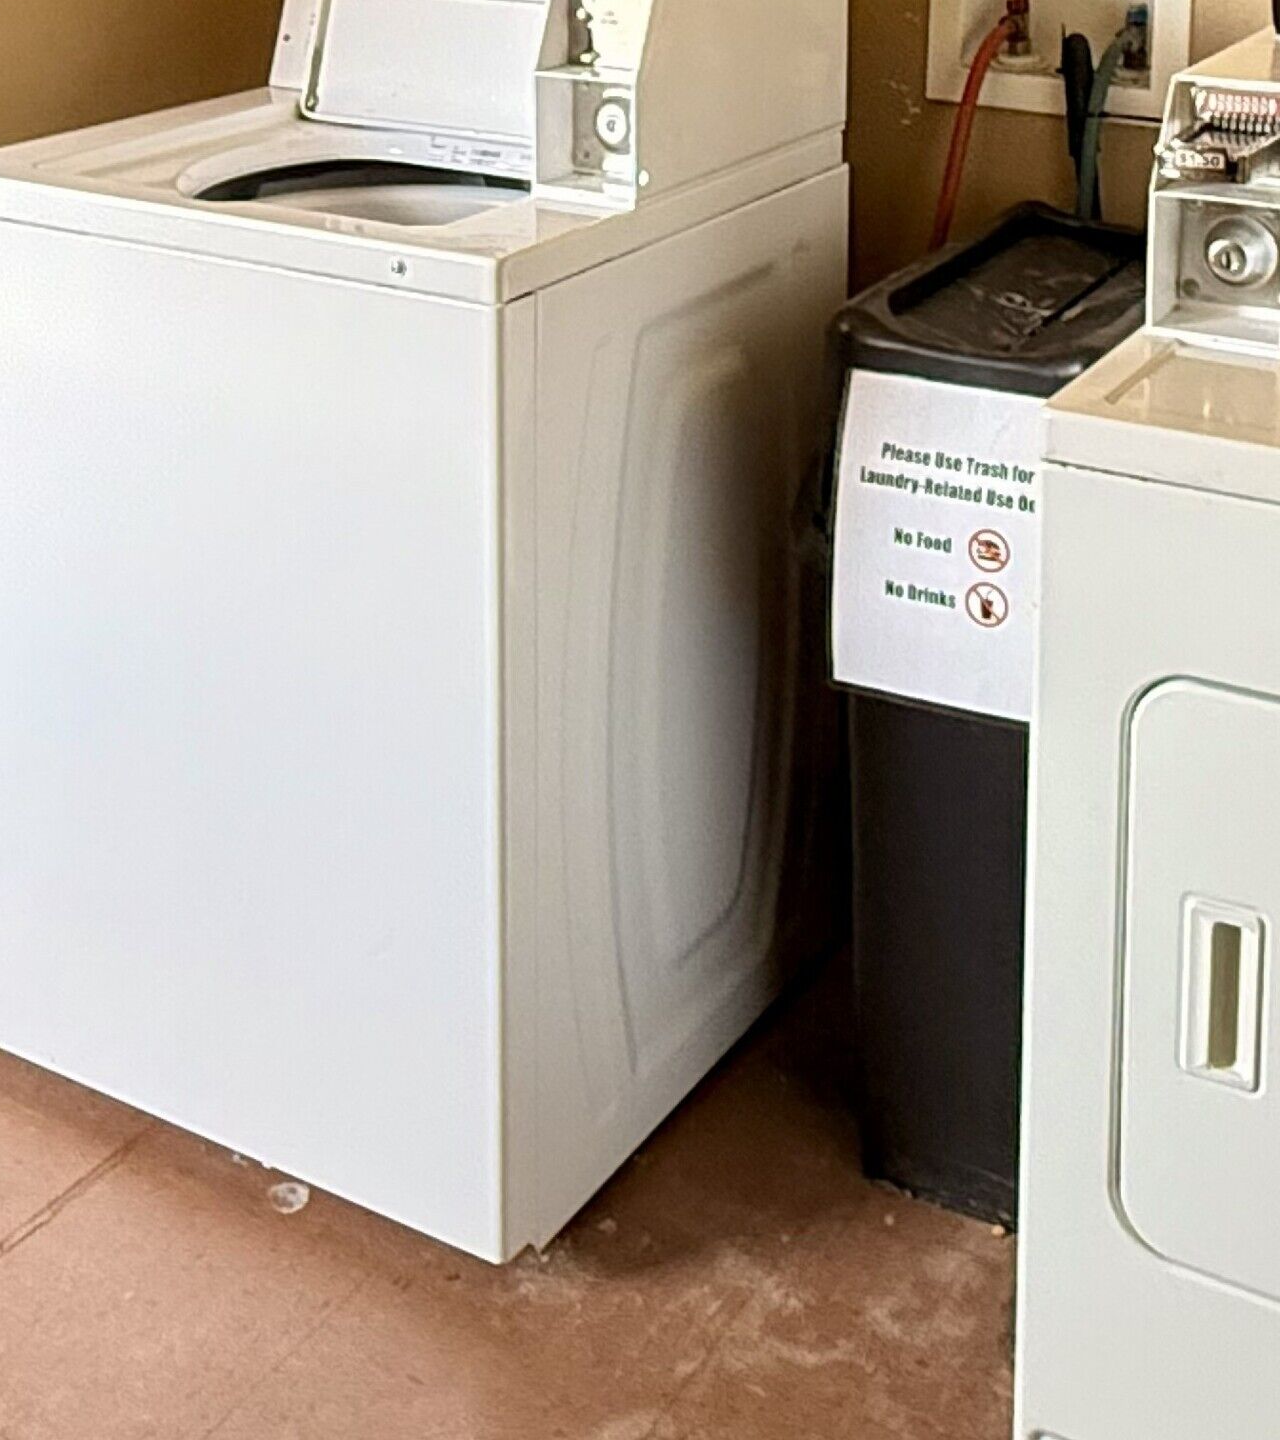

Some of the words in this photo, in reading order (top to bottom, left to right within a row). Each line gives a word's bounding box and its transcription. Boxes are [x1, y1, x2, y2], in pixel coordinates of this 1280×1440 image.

[881, 442, 931, 466] Please
[935, 451, 963, 472] Use
[966, 457, 1008, 480] Trash
[1012, 465, 1036, 484] for
[859, 466, 983, 503] Laundry-Related
[986, 489, 1014, 509] Use
[893, 527, 912, 546] No
[916, 531, 952, 553] Food
[885, 579, 904, 598] No
[907, 584, 956, 609] Drinks
